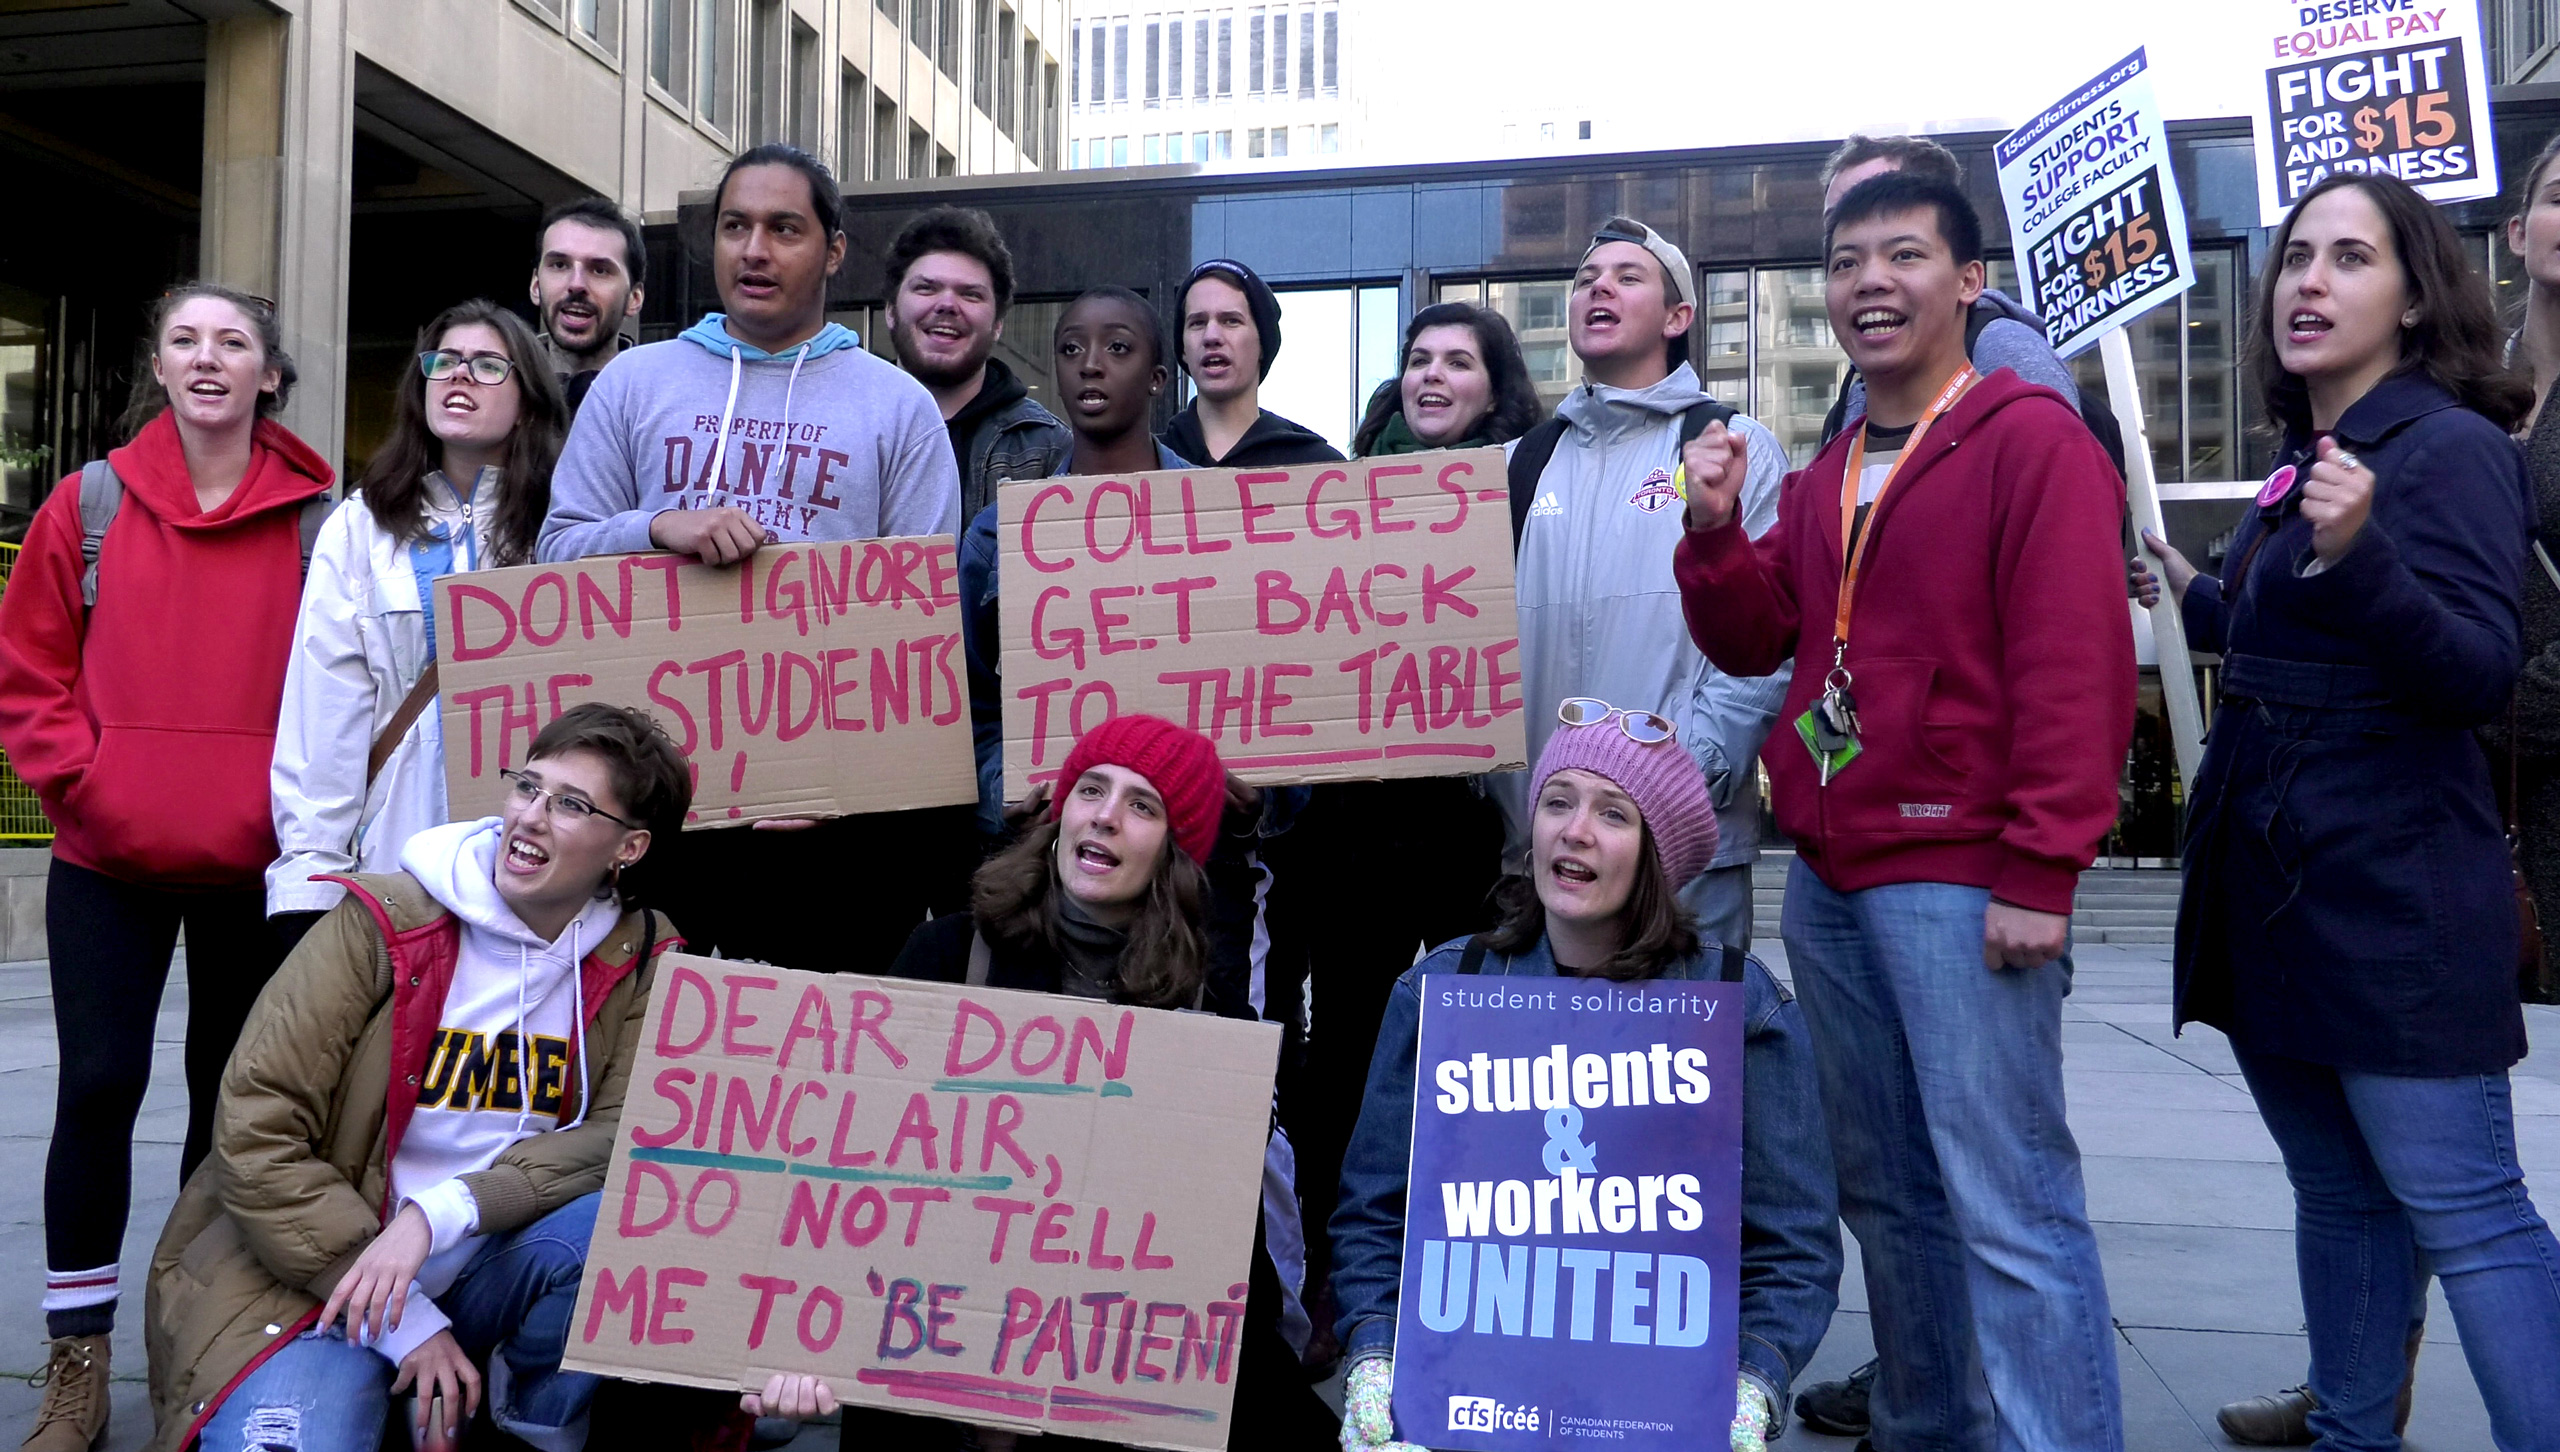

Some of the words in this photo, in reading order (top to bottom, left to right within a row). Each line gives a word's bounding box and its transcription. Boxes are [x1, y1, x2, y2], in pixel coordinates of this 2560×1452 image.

[2273, 20, 2378, 58] EQUAL
[2386, 8, 2447, 38] PAY
[2300, 0, 2414, 27] DESERVE
[2003, 59, 2140, 158] 15andfairness.org
[2277, 46, 2449, 114] FIGHT
[2029, 99, 2122, 177] STUDENTS
[2282, 111, 2347, 142] FOR
[2353, 91, 2457, 153] $15
[2285, 136, 2350, 167] AND
[2022, 110, 2140, 212] SUPPORT
[2022, 180, 2081, 234] COLLEGE
[2083, 136, 2151, 190] FACULTY
[2034, 176, 2148, 282] FIGHT
[2040, 264, 2082, 305] FOR
[2083, 212, 2158, 289] $15
[2045, 253, 2171, 347] FAIRNESS
[2045, 283, 2084, 324] AND
[693, 414, 799, 440] PRPERTY
[801, 423, 828, 443] OF
[663, 436, 849, 511] DANTE
[1532, 506, 1563, 517] didas
[1636, 487, 1672, 498] TORONTO
[740, 541, 960, 637] IGNORE
[1030, 575, 1216, 670] GET
[1255, 563, 1479, 635] BACK
[647, 632, 962, 757] STUDENTS
[1017, 678, 1118, 766] TO
[1157, 664, 1314, 744] THE
[1339, 637, 1523, 733] TABLE
[654, 966, 908, 1074] DEAR
[943, 998, 1135, 1085] DON
[1441, 986, 1557, 1011] student
[1570, 988, 1719, 1022] solidarity
[1434, 1043, 1711, 1115] students
[631, 1067, 1063, 1198] SINCLAIR,
[1541, 1104, 1598, 1176] &
[619, 1159, 740, 1238] DO
[780, 1180, 952, 1249] NOT
[973, 1195, 1174, 1271] TELL
[1441, 1167, 1704, 1238] workers
[583, 1265, 708, 1346] ME
[740, 1272, 843, 1353] TO
[1419, 1239, 1711, 1348] UNITED
[1559, 1427, 1573, 1436] OF
[1575, 1427, 1625, 1440] STUDENTS
[1560, 1415, 1611, 1428] CANADIAN
[1613, 1419, 1674, 1432] FEDERATION
